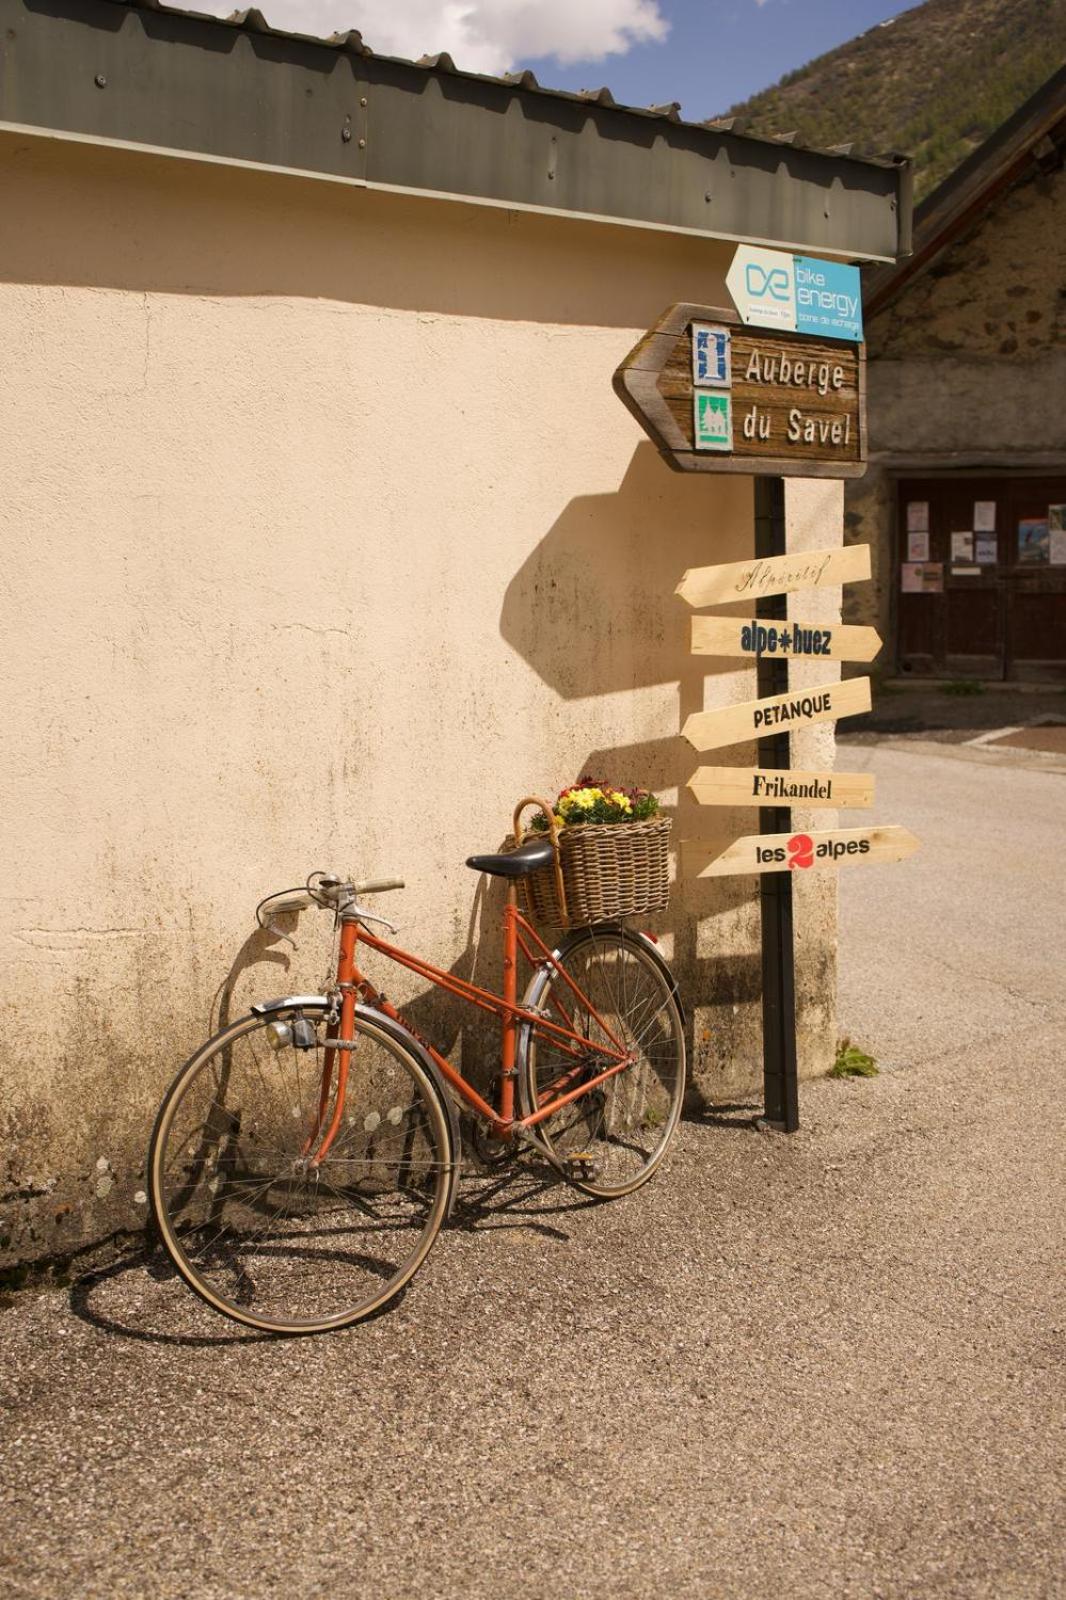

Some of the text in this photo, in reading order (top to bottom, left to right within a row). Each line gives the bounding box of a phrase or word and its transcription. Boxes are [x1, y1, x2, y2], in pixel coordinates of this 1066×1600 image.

[796, 266, 826, 286] bike
[797, 287, 859, 318] energy
[744, 348, 845, 396] Auberge
[743, 406, 851, 446] du Savel
[741, 620, 832, 659] alpe huez
[754, 693, 832, 728] PETANQUE
[752, 774, 832, 800] Frikandel
[756, 833, 871, 869] les 2 alpes
